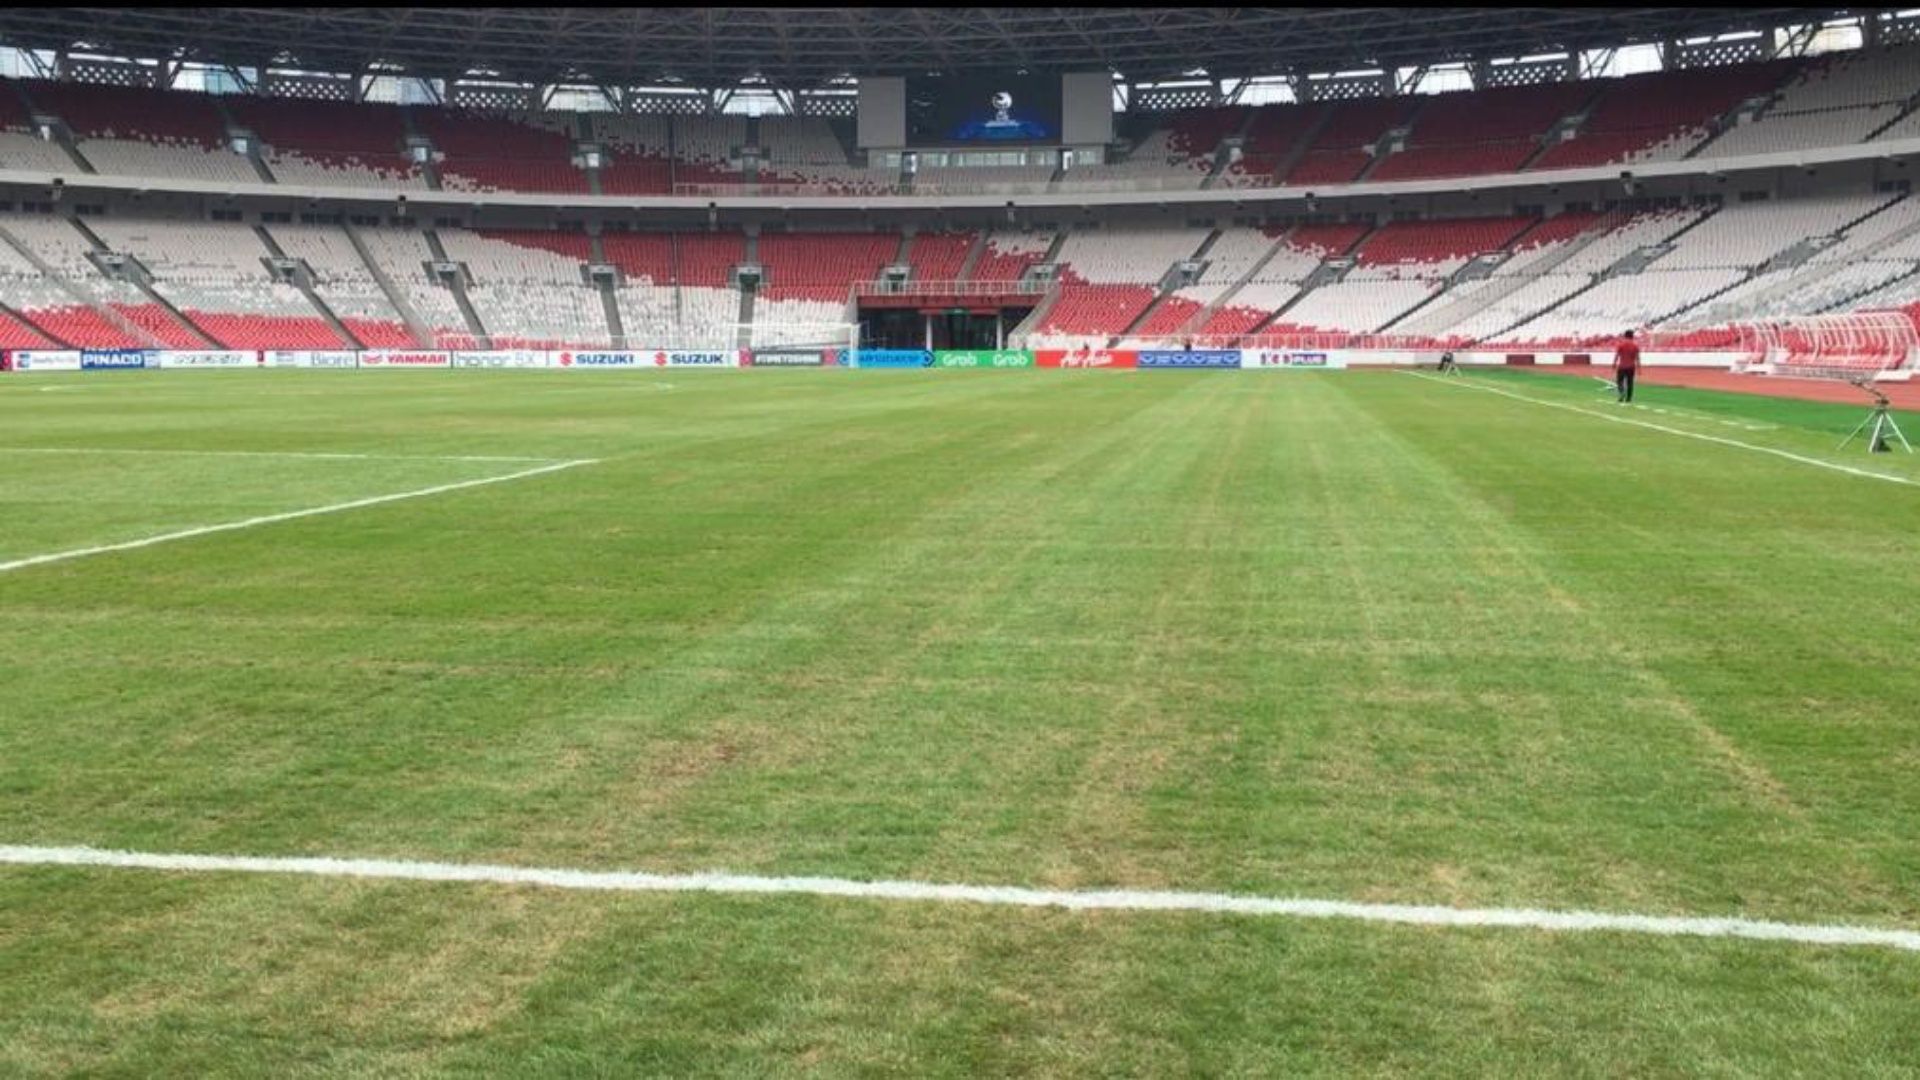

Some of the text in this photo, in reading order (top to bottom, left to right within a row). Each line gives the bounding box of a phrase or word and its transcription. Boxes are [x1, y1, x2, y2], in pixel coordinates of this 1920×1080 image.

[82, 353, 142, 366] PINACO
[387, 354, 446, 364] YANMAR
[576, 354, 634, 364] SUZUKI
[942, 352, 977, 366] Grab
[992, 352, 1028, 366] Grab
